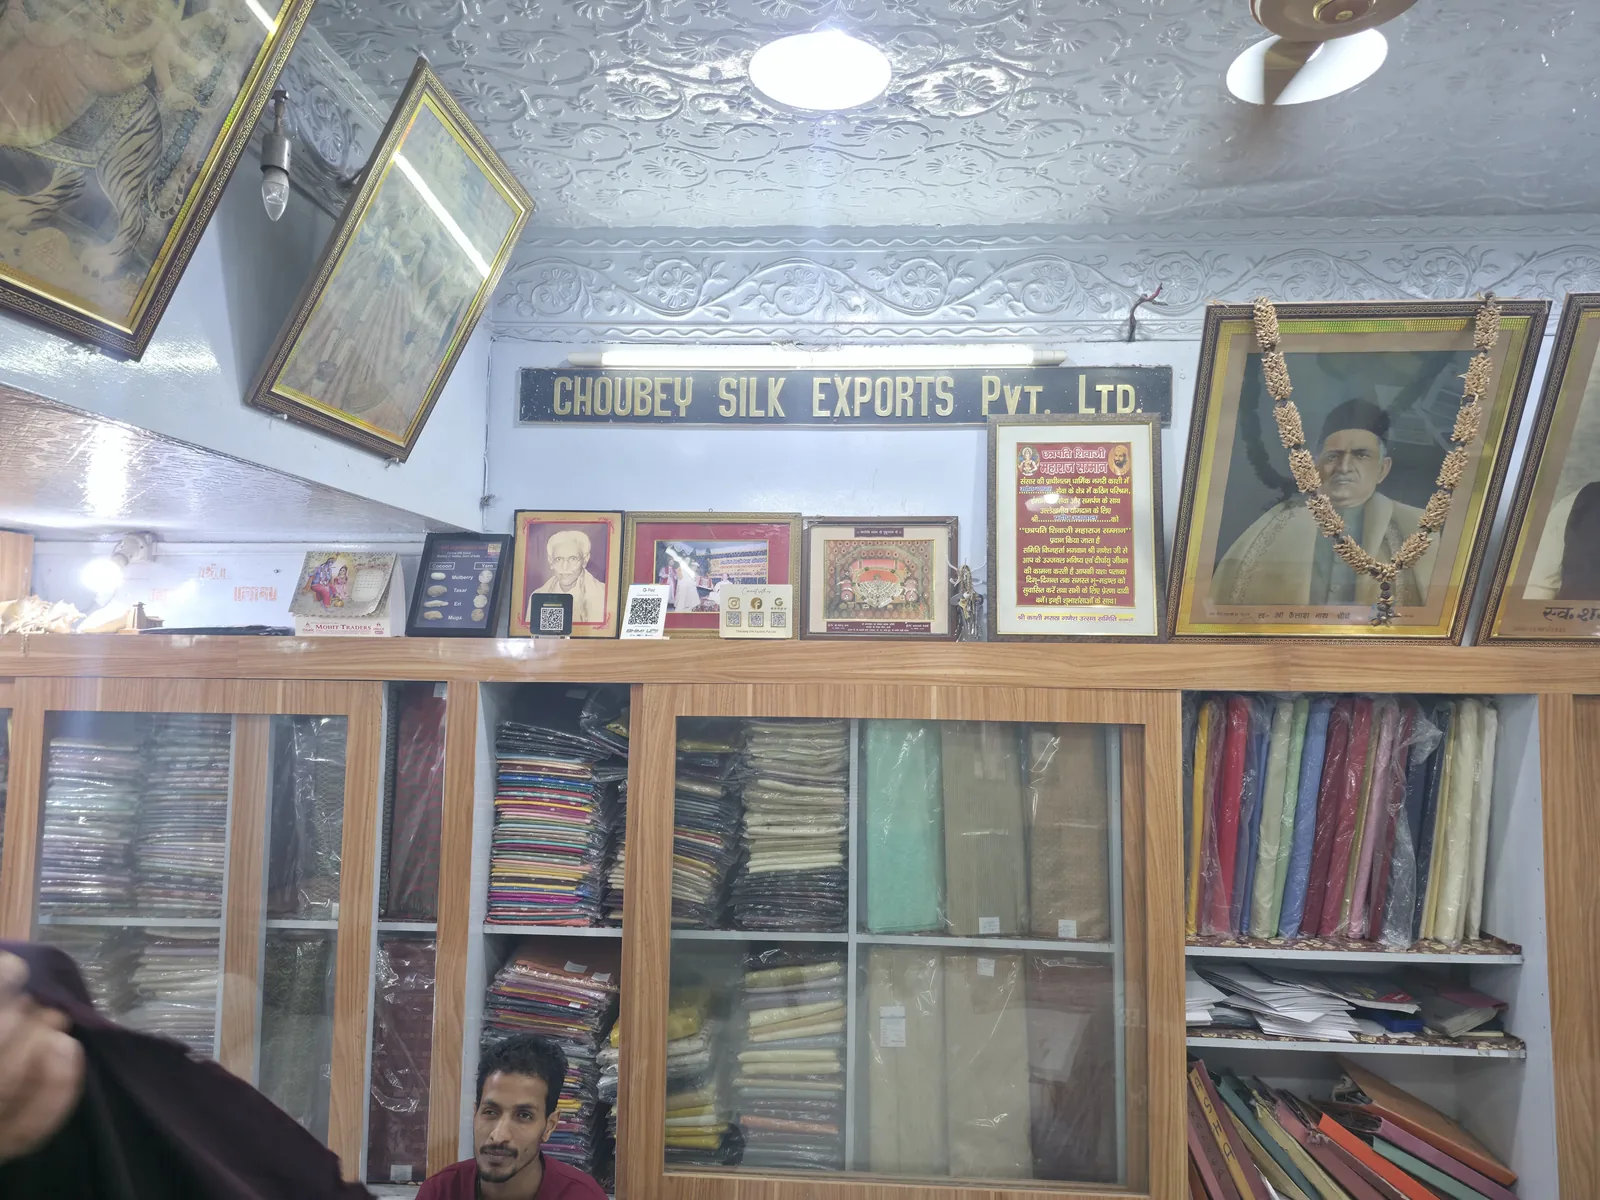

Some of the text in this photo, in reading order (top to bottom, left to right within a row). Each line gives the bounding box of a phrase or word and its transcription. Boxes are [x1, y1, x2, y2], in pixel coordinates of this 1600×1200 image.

[553, 376, 693, 418] CHOUBEY
[718, 377, 785, 418] SILK
[812, 376, 954, 417] EXPORTS
[1041, 447, 1106, 459] छत्रपति शिवाजी
[1040, 462, 1108, 475] महाराज सम्मान
[1037, 476, 1044, 485] की
[1108, 476, 1122, 485] काशी
[1048, 526, 1073, 534] शिवाजी
[1065, 535, 1079, 544] किया
[1023, 545, 1040, 553] समिति
